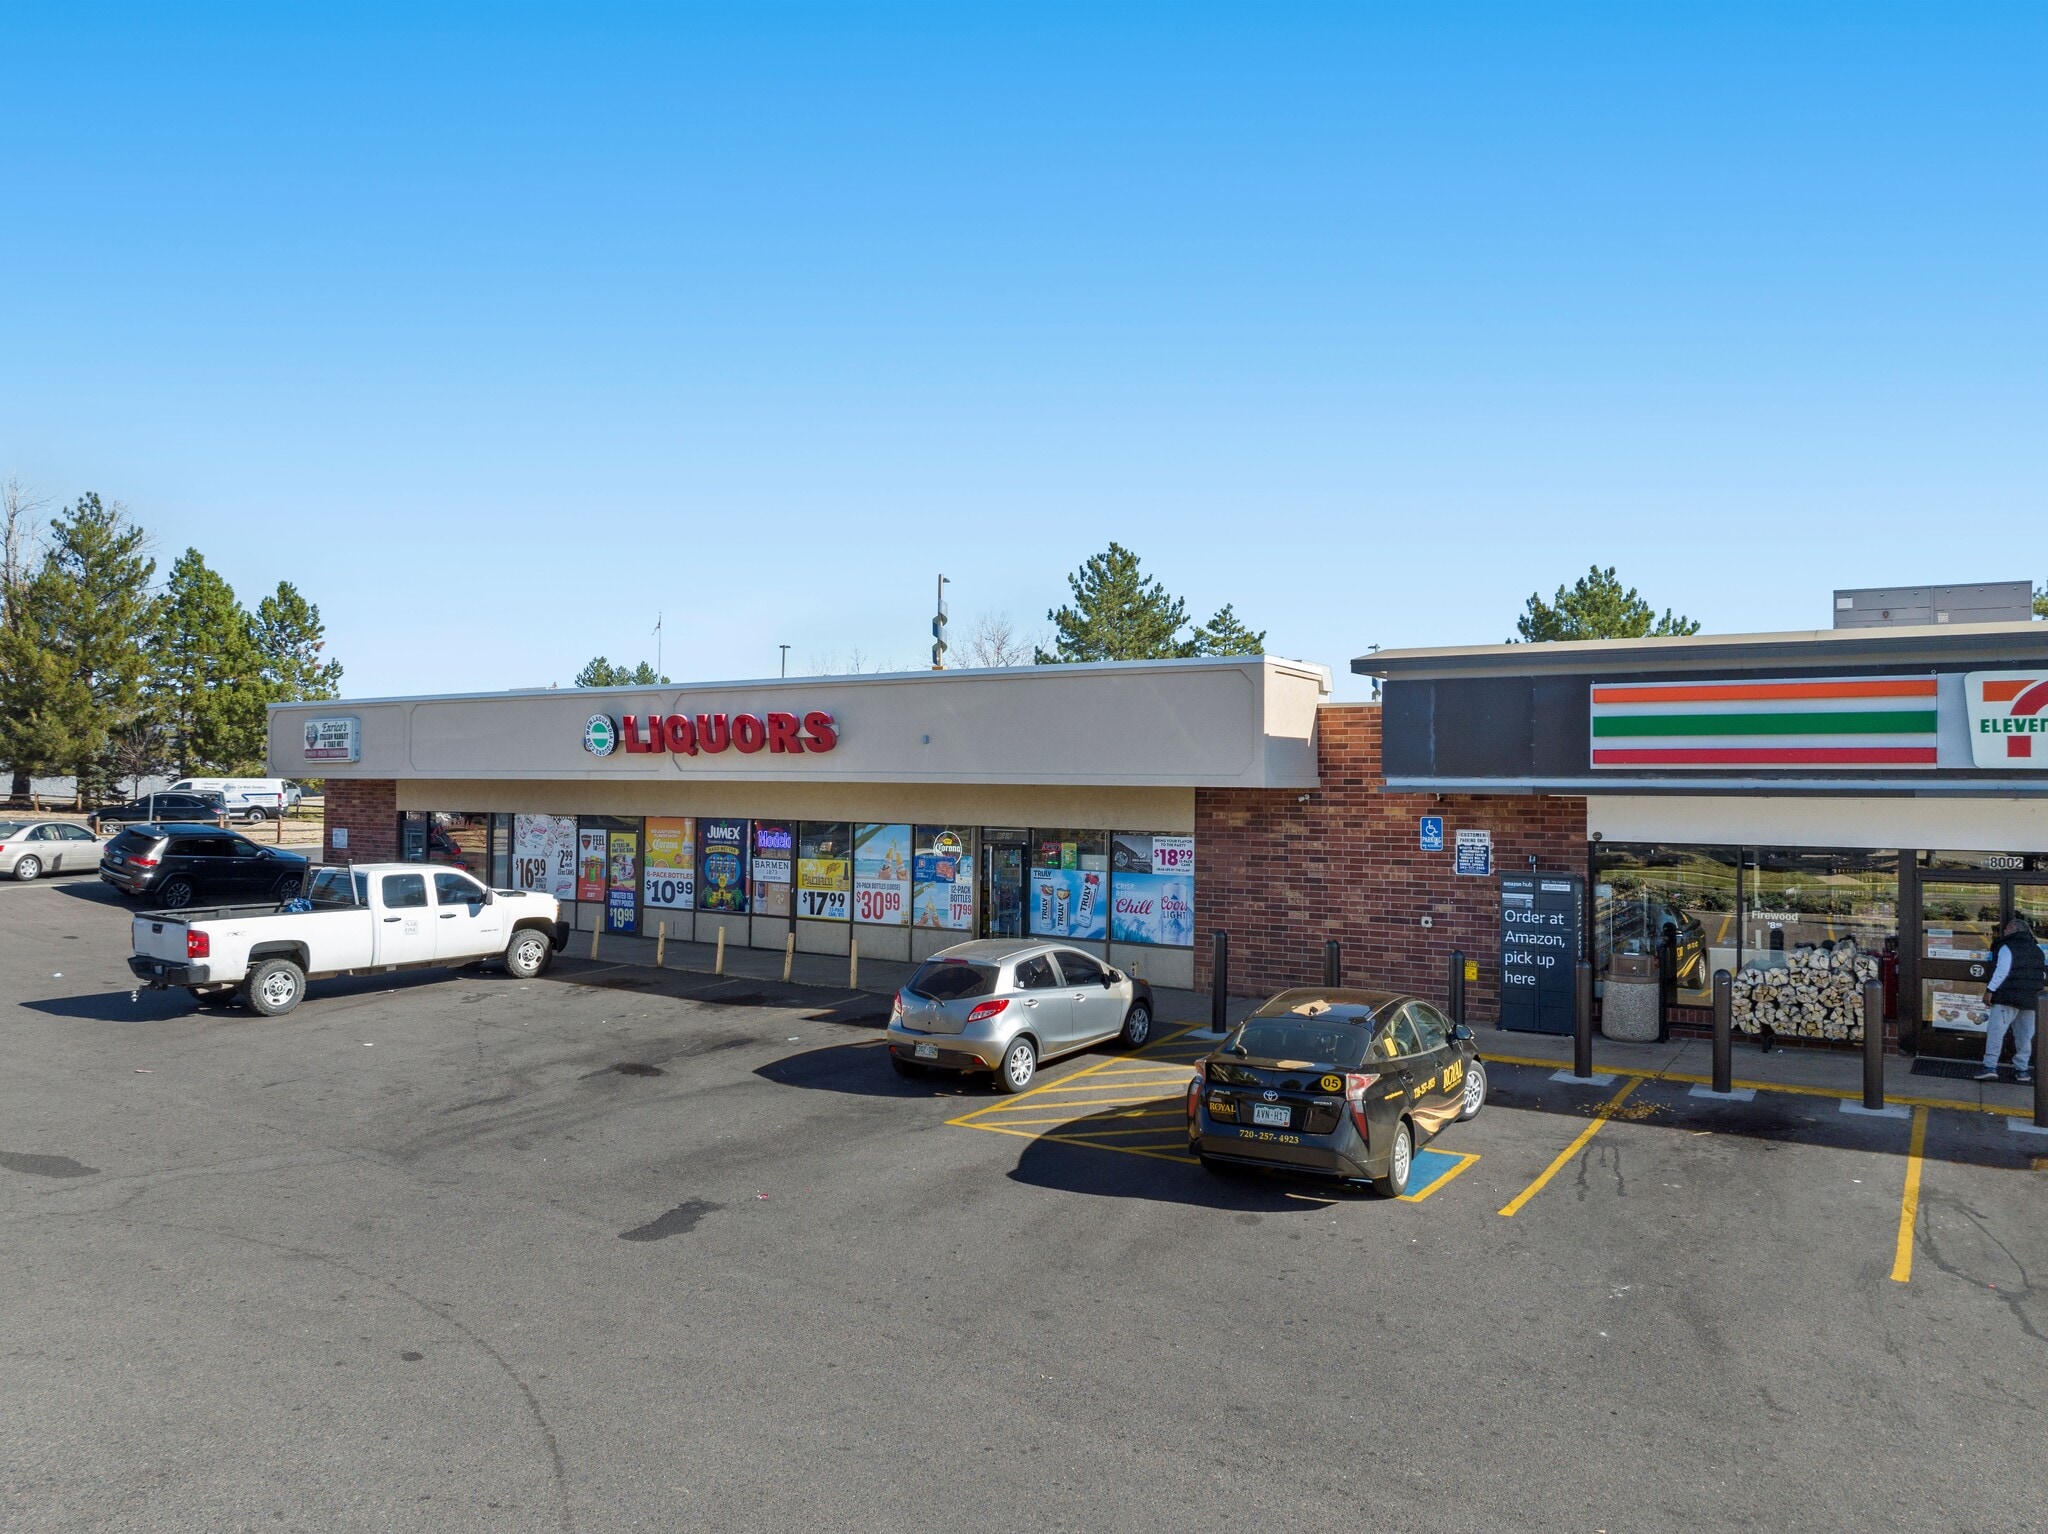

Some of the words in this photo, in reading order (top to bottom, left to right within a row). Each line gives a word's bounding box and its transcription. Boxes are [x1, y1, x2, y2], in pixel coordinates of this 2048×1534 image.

[623, 711, 838, 757] LIQUORS
[707, 825, 740, 840] JUMEX
[593, 834, 605, 846] FEEL
[757, 830, 791, 849] Modelo
[935, 843, 961, 853] Corona
[754, 860, 789, 870] BARMEN
[1989, 856, 2023, 869] 8002
[667, 872, 693, 880] BOTTLES
[1033, 870, 1052, 878] TRULY
[886, 883, 901, 891] (LOOSE)
[950, 885, 971, 894] 12-PACK
[611, 891, 626, 899] TWISTED
[626, 892, 634, 900] TEA
[950, 894, 972, 903] BOTTLES
[1080, 885, 1092, 912] TRULY
[610, 899, 622, 907] PARTY
[621, 899, 635, 908] POUCH
[1115, 897, 1154, 915] Chill
[1161, 895, 1188, 912] Coors
[1163, 911, 1187, 920] LIGHT
[1504, 909, 1545, 924] Order
[1549, 913, 1565, 925] at
[1751, 910, 1799, 921] Firewood
[1504, 930, 1566, 949] Amazon,
[1504, 951, 1533, 966] pick
[1537, 955, 1555, 969] up
[1504, 970, 1536, 985] here
[1442, 1058, 1464, 1089] ROYAL
[1323, 1077, 1339, 1088] 05
[1209, 1102, 1236, 1113] ROYAL
